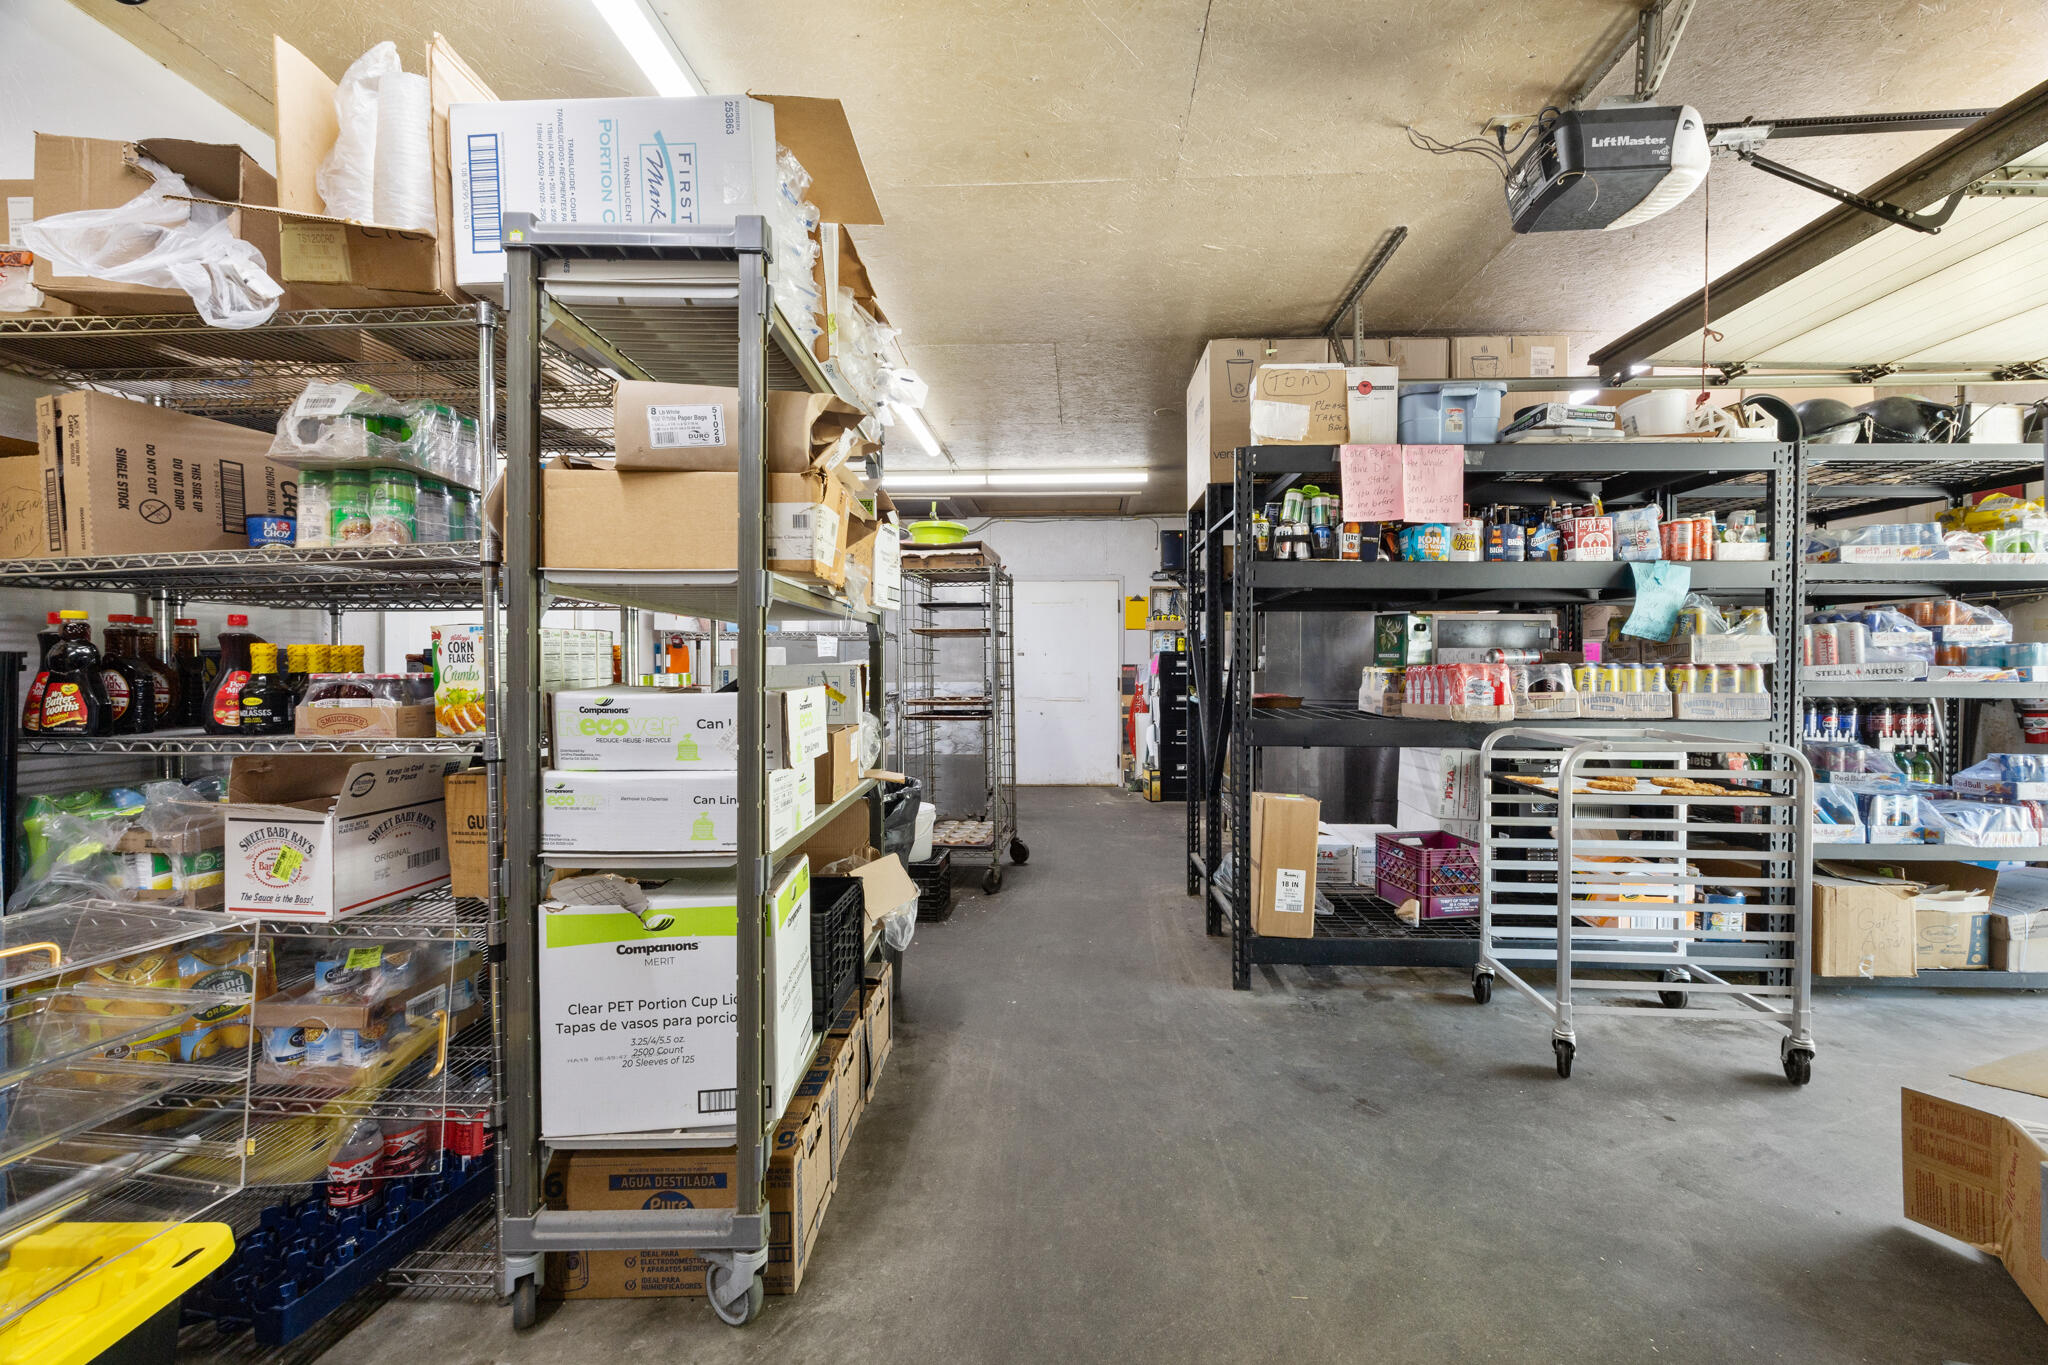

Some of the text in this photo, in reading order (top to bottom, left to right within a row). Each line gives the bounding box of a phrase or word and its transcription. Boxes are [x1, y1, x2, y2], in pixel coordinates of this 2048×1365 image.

[725, 101, 734, 135] 253863
[1591, 135, 1666, 148] LiftMaster
[599, 119, 613, 202] PORTION
[624, 156, 632, 222] TRANSLUCENT
[646, 150, 667, 224] Mark
[679, 153, 692, 223] FIRST
[146, 444, 157, 495] DO NOT CUT
[115, 448, 129, 510] SINGLE STOCK
[265, 466, 274, 487] CHOW
[173, 458, 185, 511] DO NOT DROP
[191, 463, 202, 512] THIS SIDE UP
[267, 489, 276, 507] MEIN
[264, 522, 277, 530] LA
[264, 529, 290, 538] CHOY
[1547, 531, 1560, 540] MOON
[1418, 536, 1446, 545] KONA
[448, 642, 473, 653] CORN
[449, 653, 474, 663] FLAKES
[443, 665, 480, 683] Crumbs
[1864, 667, 1904, 675] ARTOIS
[579, 707, 629, 715] Companions
[321, 714, 365, 725] SMUCKER'S
[697, 719, 723, 730] Can
[386, 768, 402, 776] Keep
[388, 776, 399, 784] Dry
[693, 795, 715, 805] Can
[368, 818, 393, 844] SWEET
[395, 812, 416, 825] BABY
[416, 813, 436, 832] RAY'S
[239, 828, 264, 852] SWEET
[267, 827, 289, 838] BABY
[291, 832, 315, 855] RAY'S
[374, 848, 411, 864] ORIGINAL
[241, 893, 252, 901] The
[254, 893, 273, 902] Sauce
[283, 895, 292, 903] the
[294, 895, 313, 904] Boss!
[616, 941, 699, 956] Companions
[645, 957, 676, 966] MERIT
[568, 996, 718, 1015] Clear PET Portion Cup
[556, 1023, 595, 1035] Tapas
[600, 1020, 617, 1031] de
[621, 1019, 658, 1030] vasos
[663, 1016, 692, 1029] para
[633, 1046, 684, 1057] 2500 Count
[622, 1059, 633, 1068] 20
[636, 1057, 668, 1067] Sleeves
[670, 1056, 680, 1065] of
[682, 1055, 695, 1064] 125
[621, 1176, 717, 1188] AGUA DESTILADA
